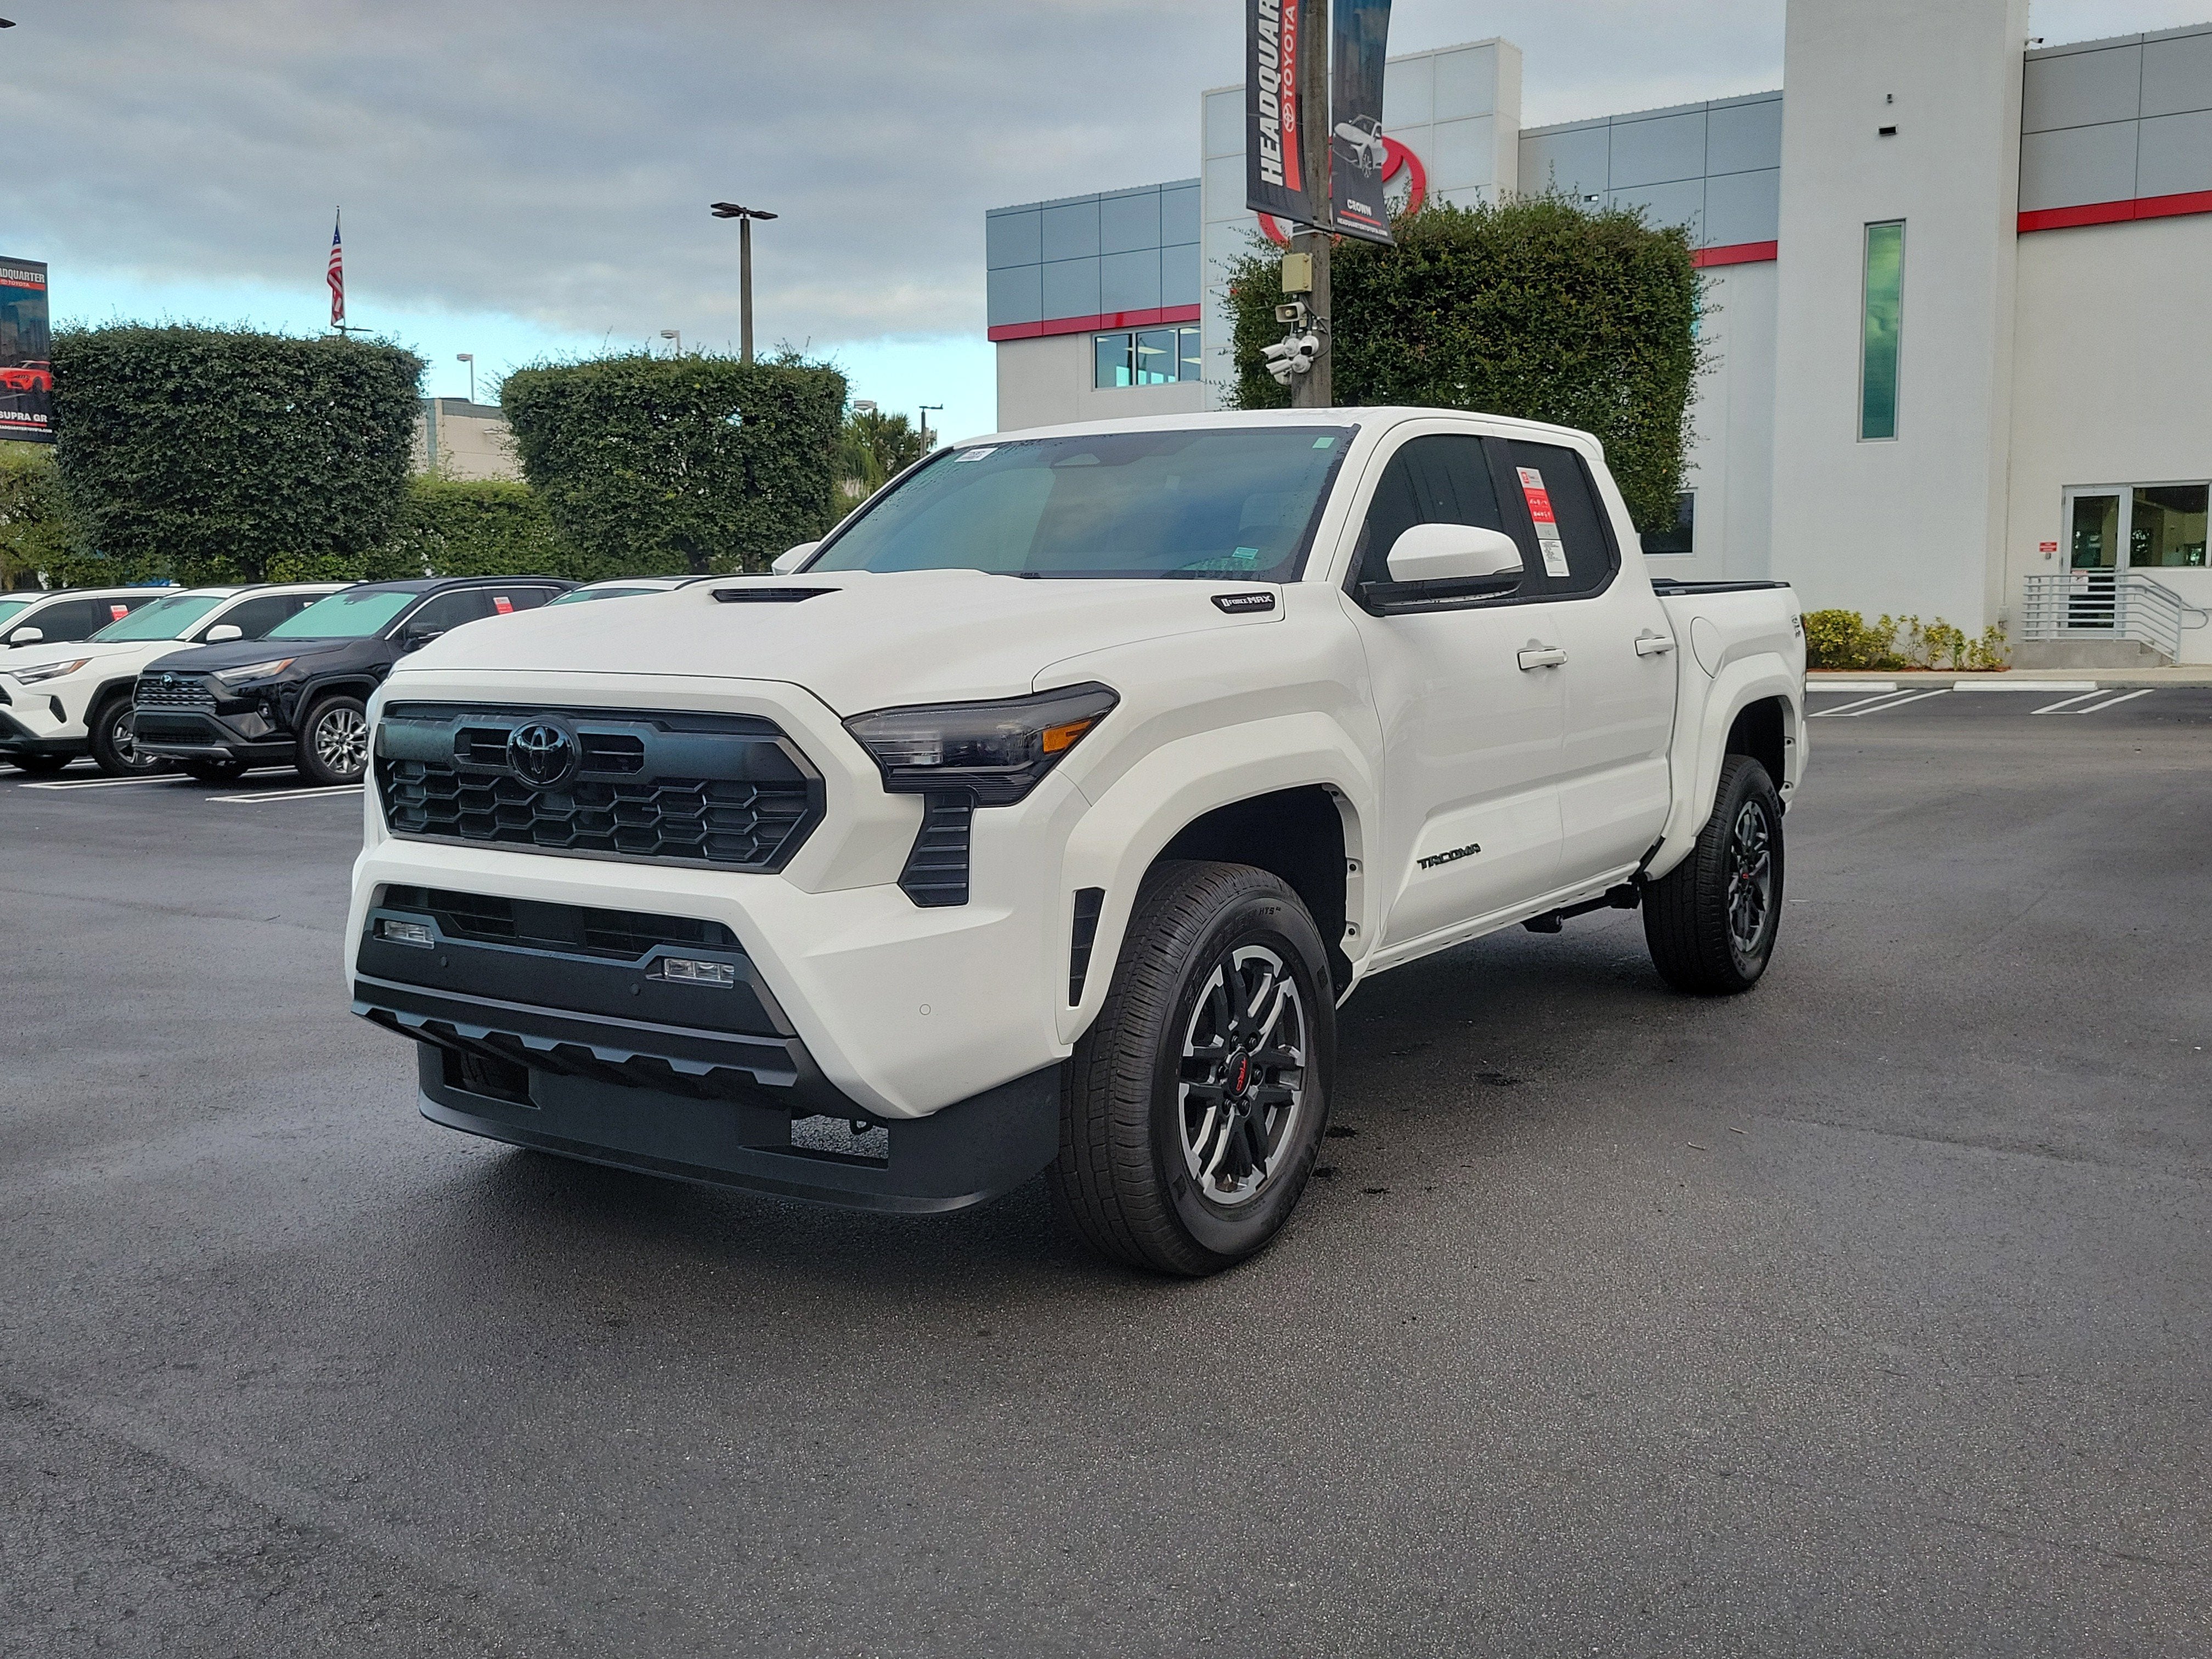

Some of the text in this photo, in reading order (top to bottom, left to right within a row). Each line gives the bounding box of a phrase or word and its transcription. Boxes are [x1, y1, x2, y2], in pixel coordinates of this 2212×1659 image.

[1284, 5, 1295, 99] TOYOTA
[1347, 199, 1372, 216] CROWN
[1417, 843, 1481, 870] TACOMA
[1236, 1057, 1247, 1092] TRD
